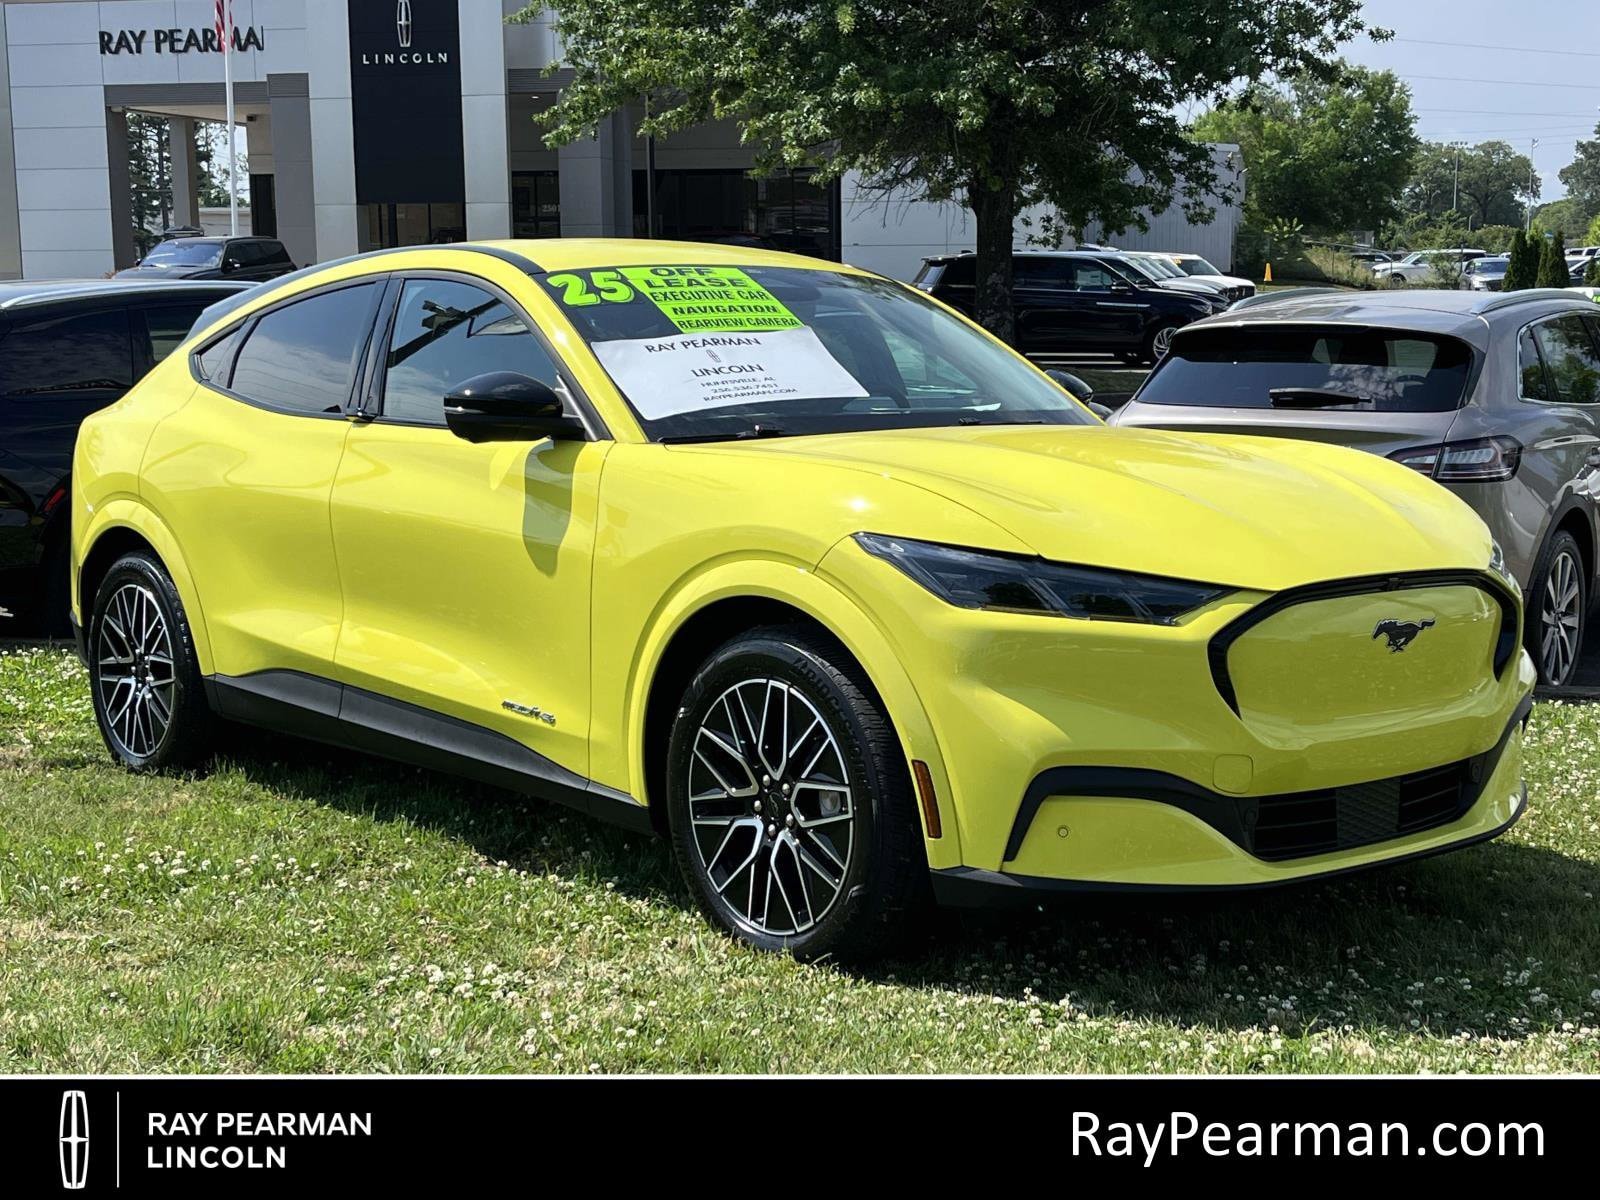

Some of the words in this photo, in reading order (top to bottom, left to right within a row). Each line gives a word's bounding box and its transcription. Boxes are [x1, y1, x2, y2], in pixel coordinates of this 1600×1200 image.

[99, 30, 147, 55] RAY
[154, 25, 264, 53] PEARMA
[362, 53, 448, 65] LINCOLN
[649, 267, 717, 278] OFF
[546, 272, 635, 307] 25
[643, 278, 750, 289] LEASE
[650, 290, 736, 302] EXECUTIVE
[737, 290, 771, 301] CAR
[671, 305, 778, 316] NAVIGATION
[677, 318, 745, 330] REARVIEW
[745, 317, 799, 327] CAMERA
[644, 342, 677, 353] RAY
[680, 337, 763, 350] PEARMAN
[691, 364, 766, 377] LINCOLN
[703, 388, 799, 402] RAYPEARMAN.COM
